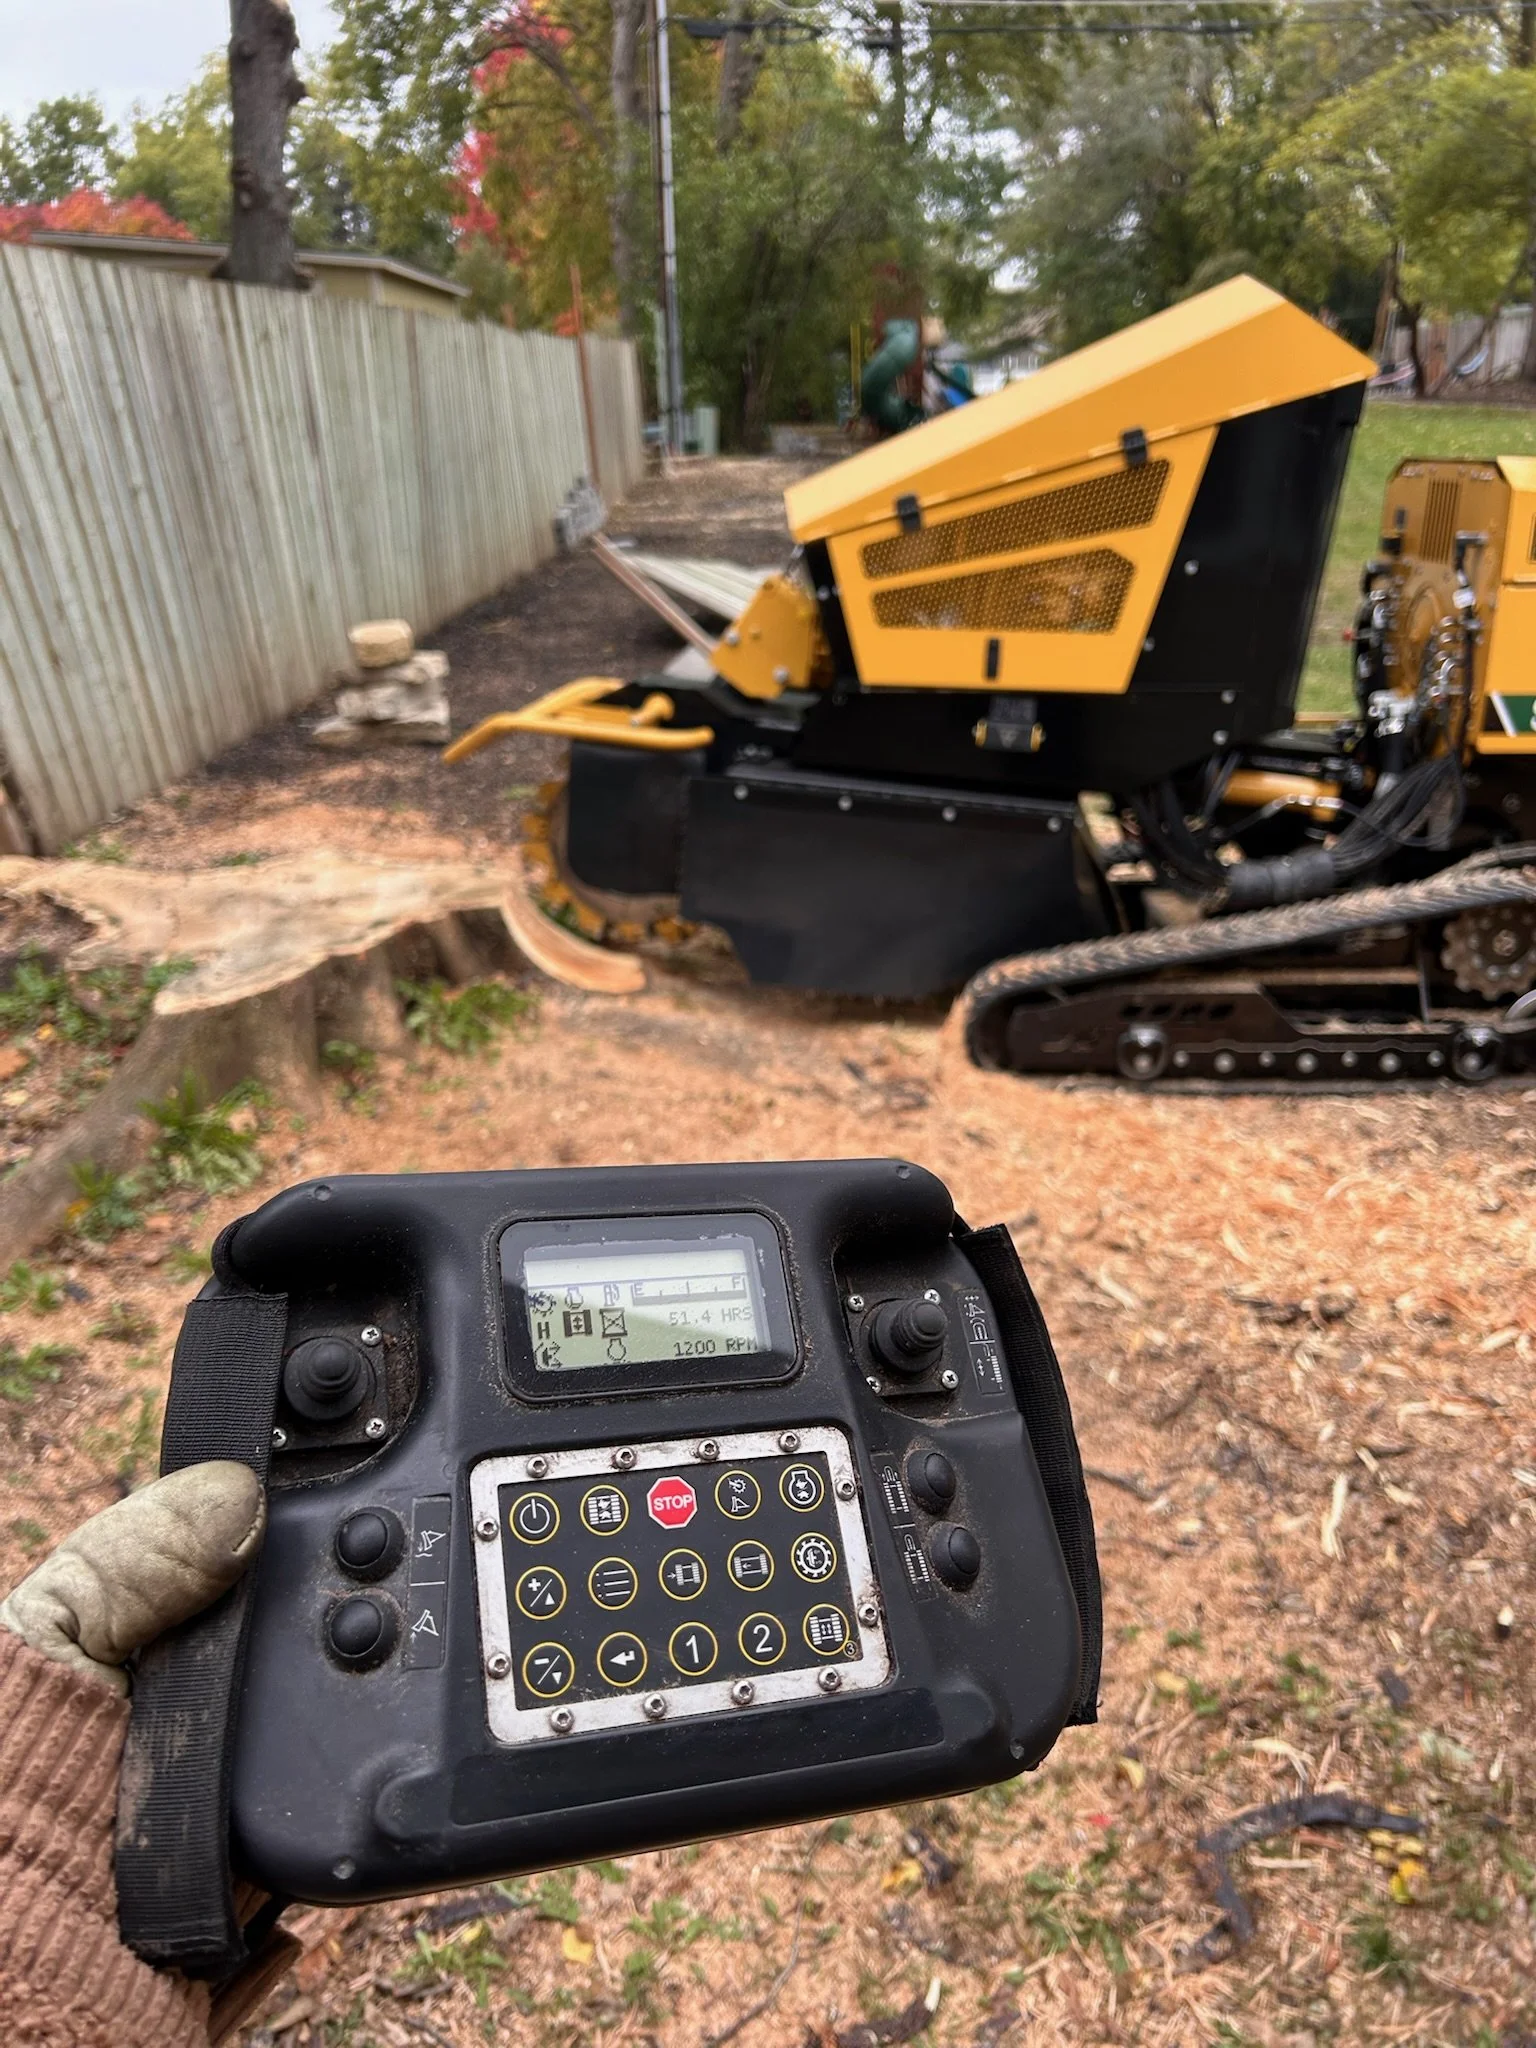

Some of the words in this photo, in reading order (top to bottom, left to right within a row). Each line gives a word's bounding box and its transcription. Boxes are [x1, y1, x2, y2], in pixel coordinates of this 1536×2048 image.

[634, 1282, 644, 1296] E
[721, 1306, 753, 1323] HRS
[538, 1321, 550, 1340] H
[673, 1339, 716, 1357] 1200
[725, 1336, 758, 1353] RPM
[653, 1494, 693, 1511] STOP
[753, 1624, 773, 1653] 2
[685, 1634, 700, 1664] 1
[846, 1643, 854, 1656] 3
